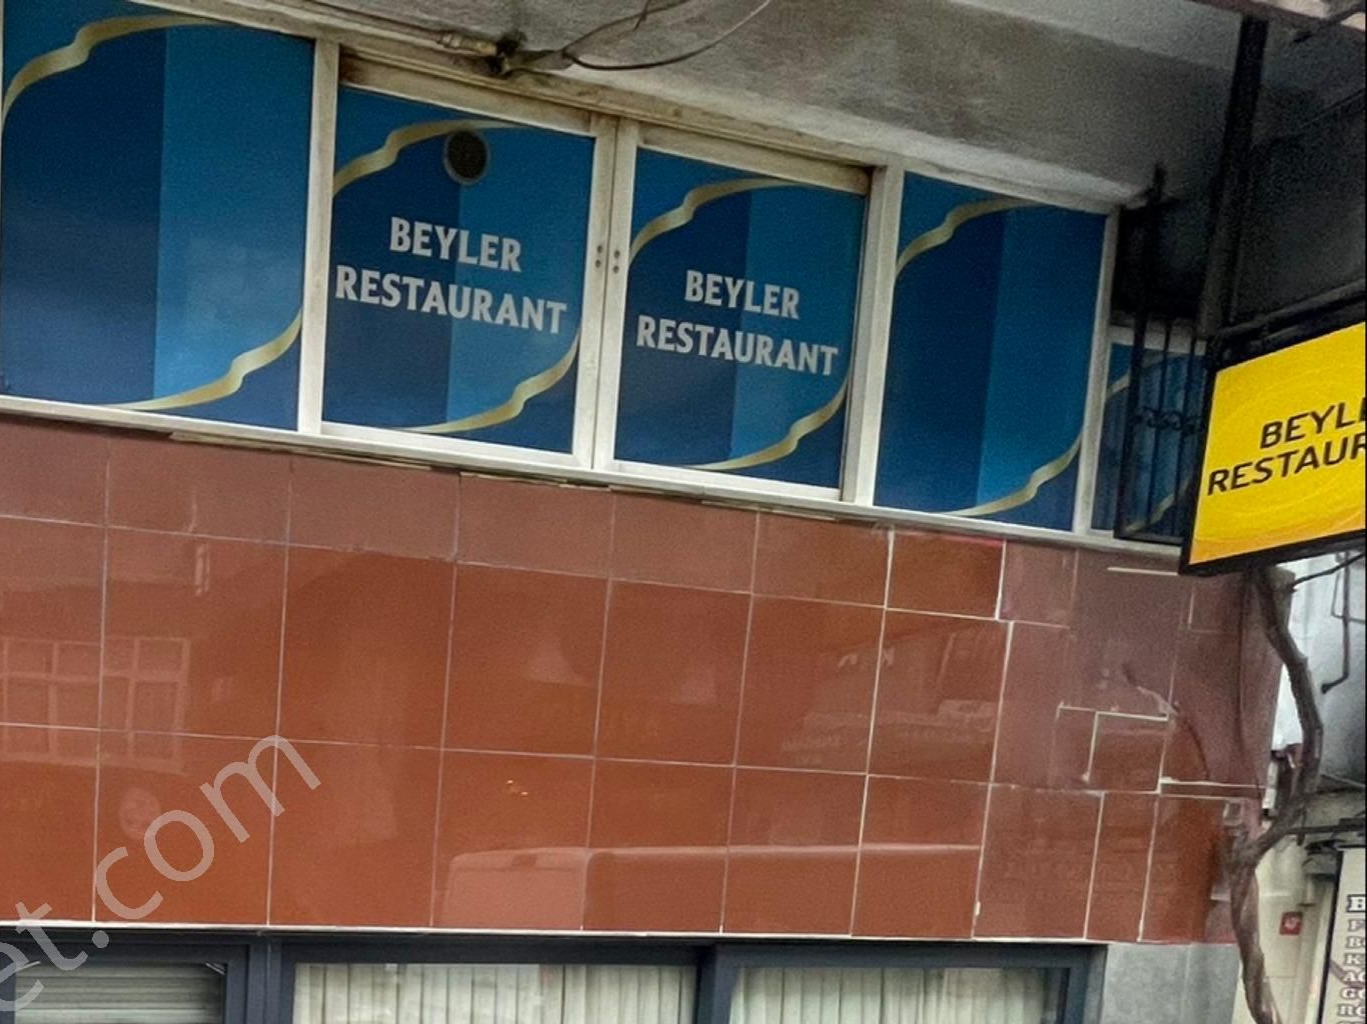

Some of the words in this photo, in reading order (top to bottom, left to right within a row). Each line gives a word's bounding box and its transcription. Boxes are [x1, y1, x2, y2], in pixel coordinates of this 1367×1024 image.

[389, 217, 522, 272] BEYLER
[335, 265, 568, 335] RESTAURANT
[684, 270, 801, 320] BEYLER
[636, 315, 839, 376] RESTAURANT
